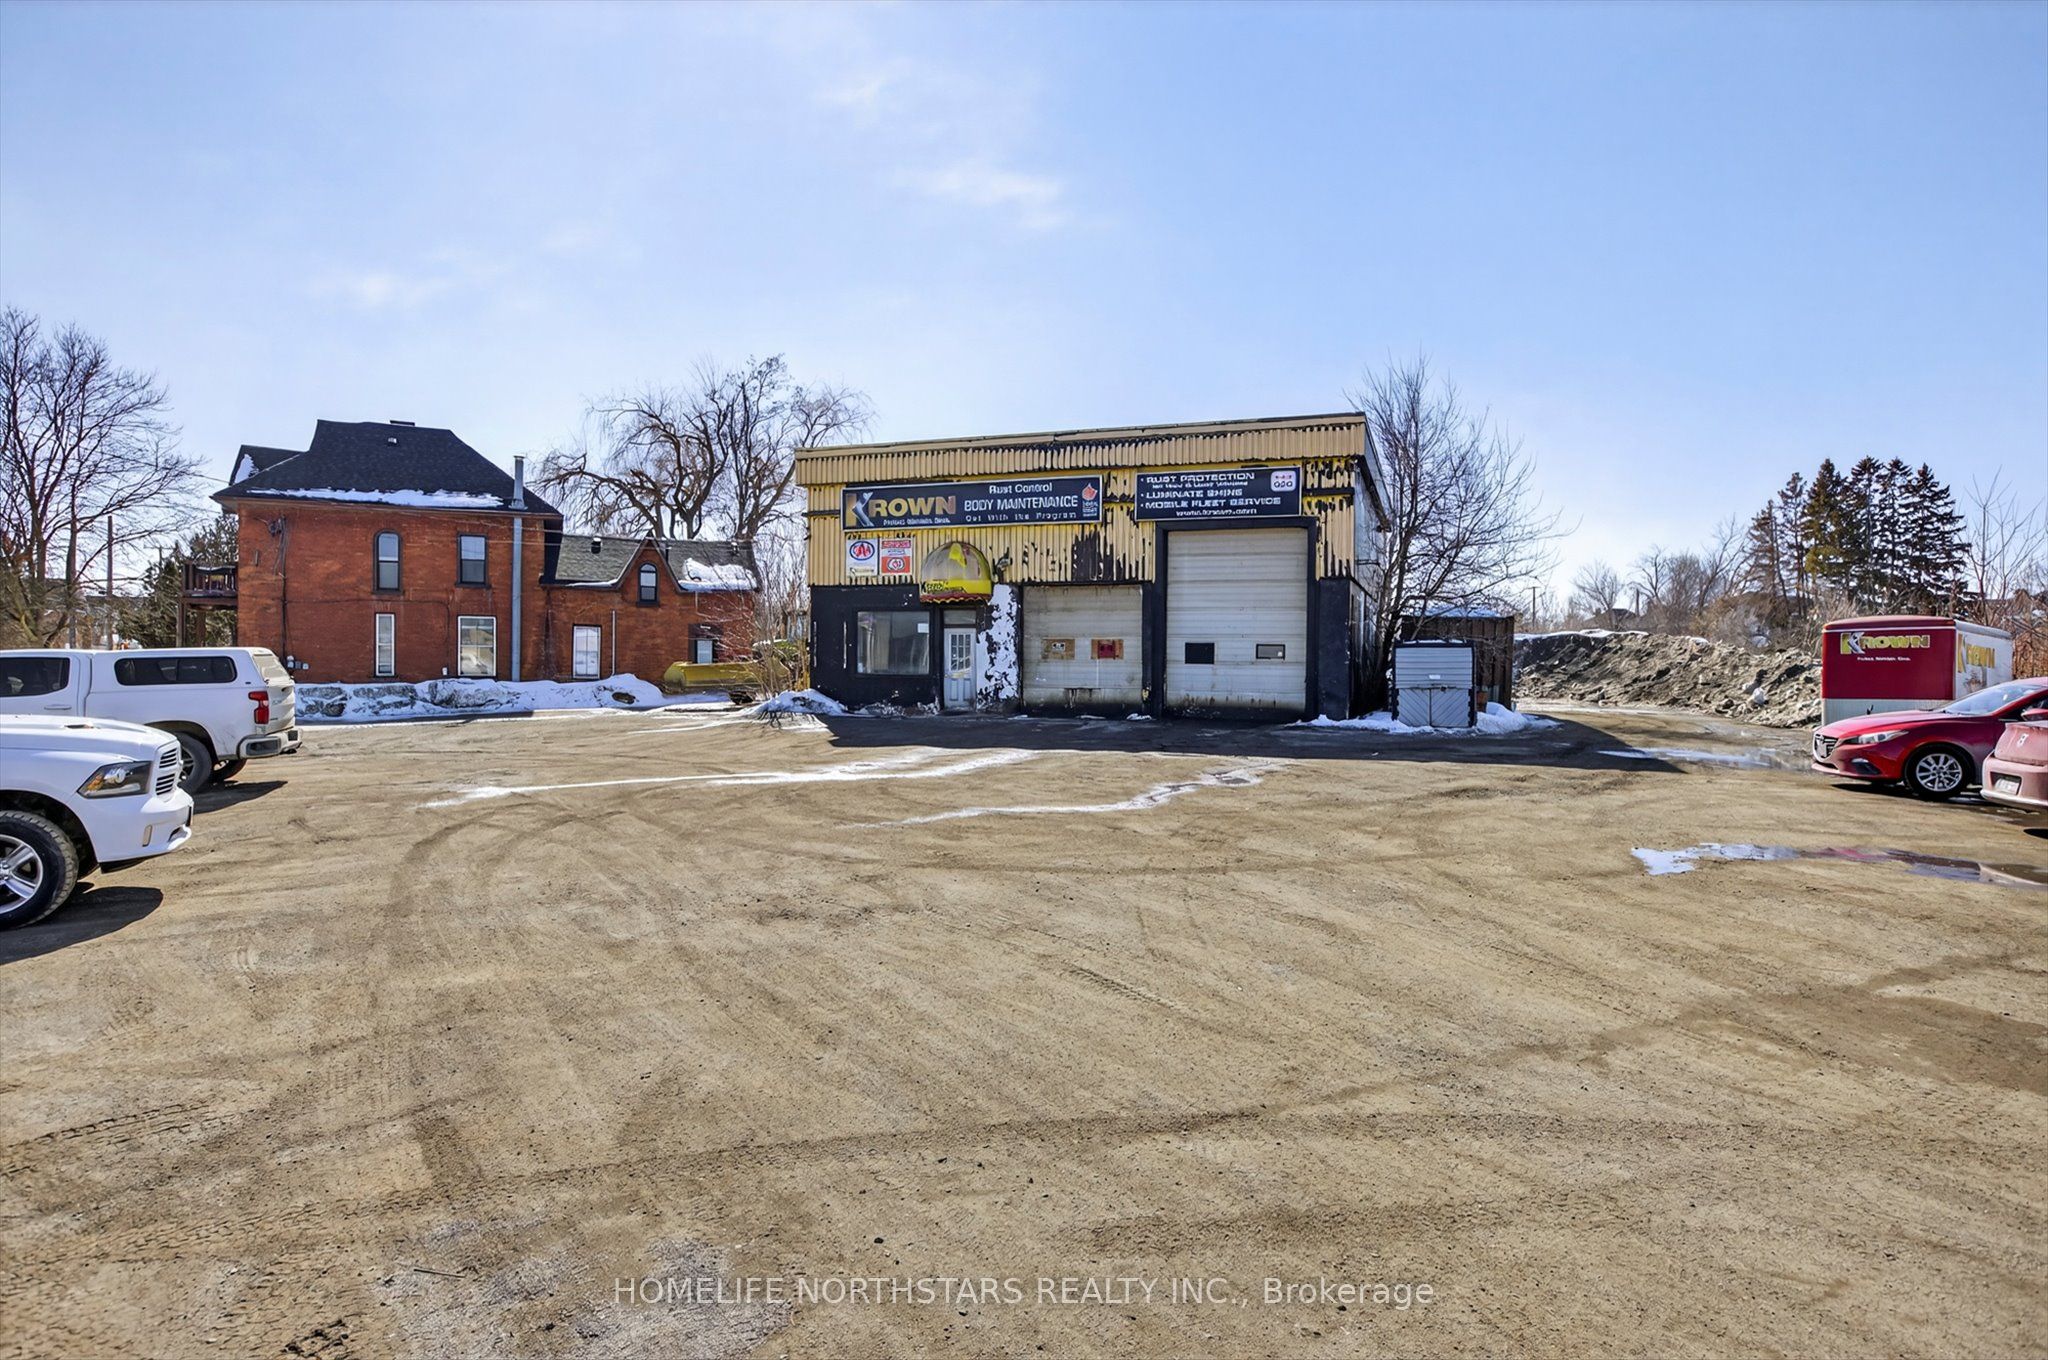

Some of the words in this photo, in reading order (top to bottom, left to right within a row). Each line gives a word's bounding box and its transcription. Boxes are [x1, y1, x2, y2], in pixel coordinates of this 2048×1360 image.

[1146, 475, 1177, 484] RUST
[1180, 472, 1255, 483] PROTECTION
[989, 484, 1012, 495] Rust
[1015, 481, 1053, 493] Control
[845, 491, 956, 527] KROWN
[964, 499, 993, 512] BODY
[997, 495, 1078, 511] MAINTENANCE
[1145, 500, 1189, 509] MOBILE
[1192, 499, 1226, 508] FLEET
[1230, 497, 1281, 507] SERVICE
[1036, 512, 1077, 522] Program
